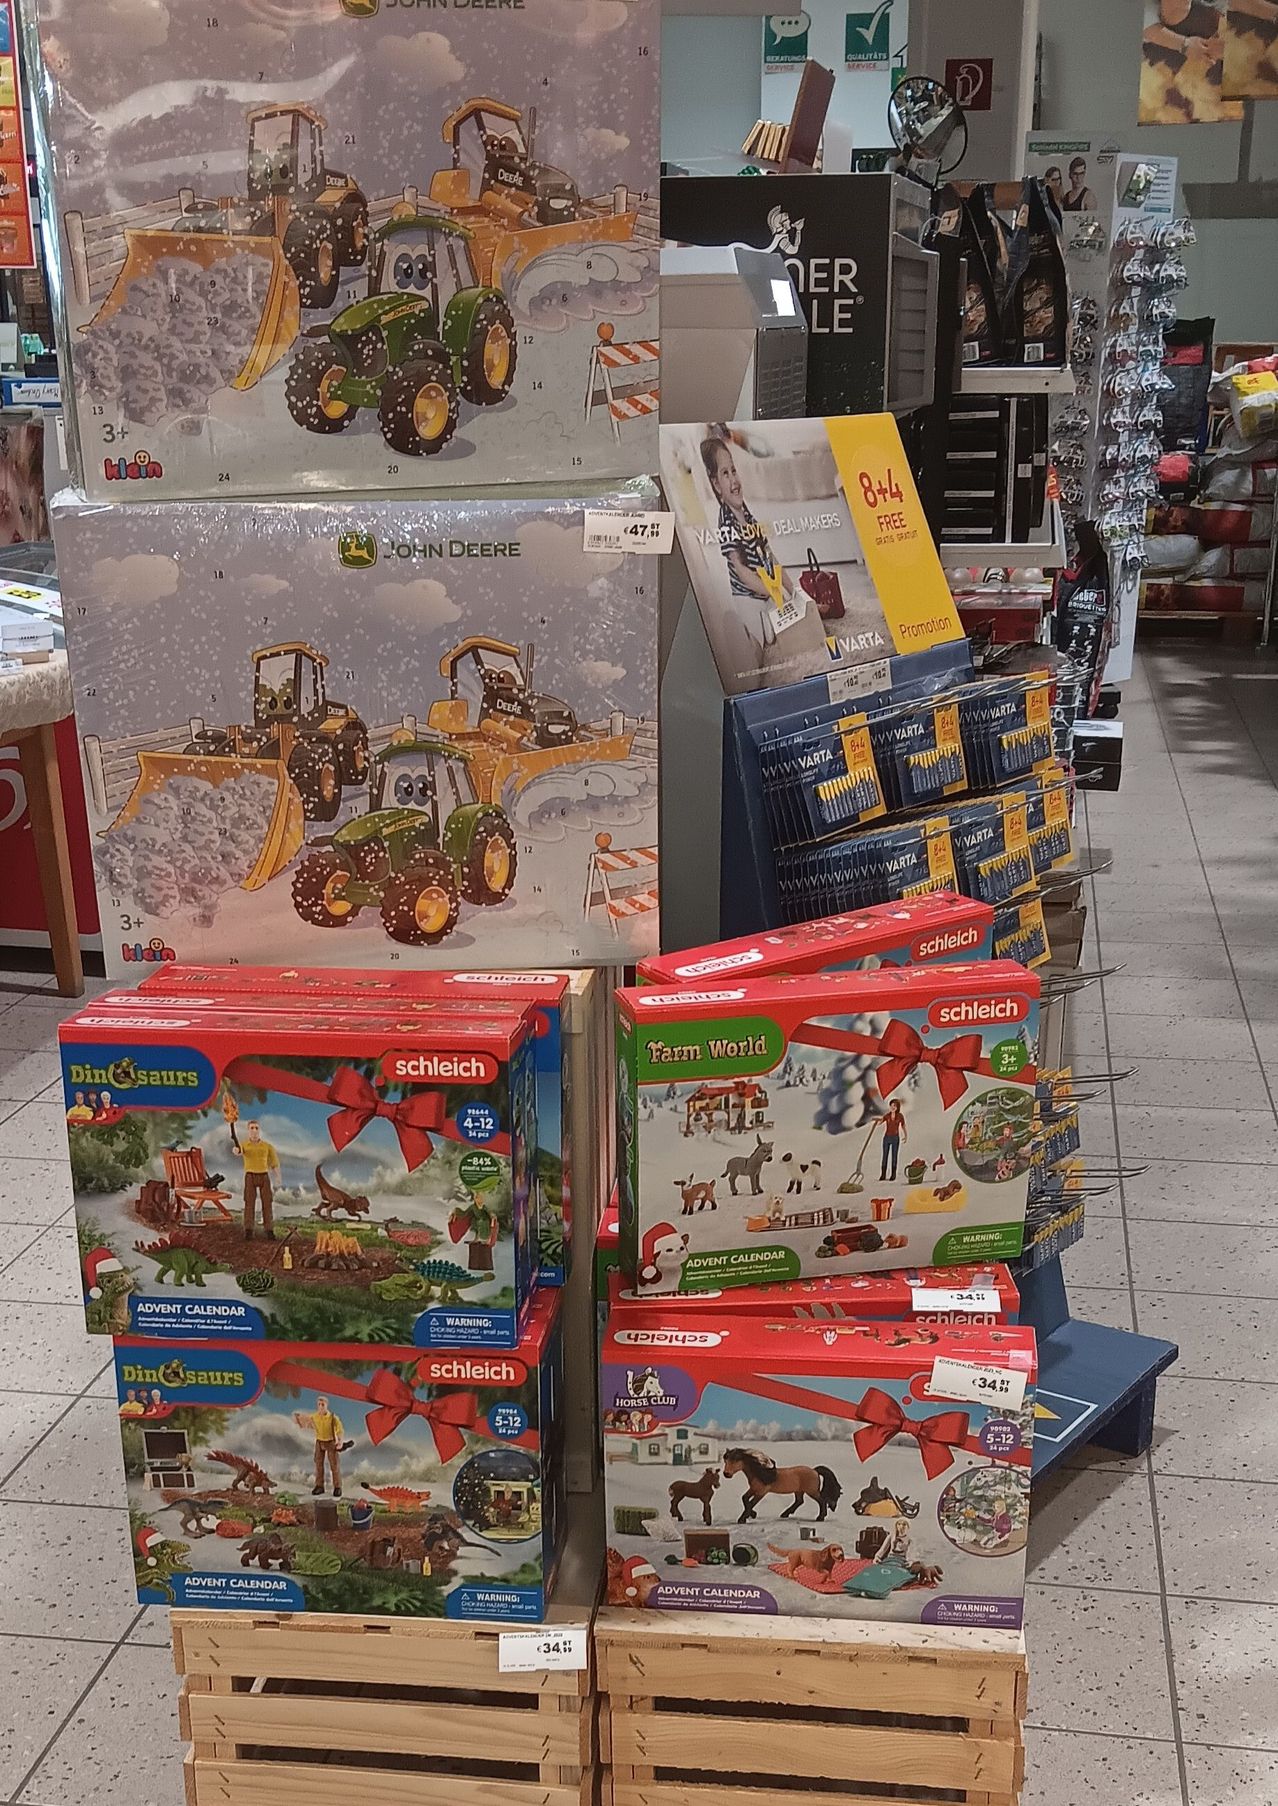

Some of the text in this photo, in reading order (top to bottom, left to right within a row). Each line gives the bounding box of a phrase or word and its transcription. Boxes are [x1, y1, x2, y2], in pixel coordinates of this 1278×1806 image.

[206, 17, 219, 28] 18
[638, 46, 649, 57] 16
[847, 53, 888, 61] QUALITÄTS
[258, 71, 265, 82] 7
[542, 77, 550, 87] 4
[344, 134, 357, 145] 21
[498, 169, 523, 187] DEERE
[638, 192, 649, 202] 19
[586, 261, 592, 270] 8
[210, 279, 216, 289] 9
[169, 293, 181, 303] 10
[346, 289, 357, 299] 11
[562, 293, 568, 303] 6
[207, 316, 219, 326] 23
[523, 336, 534, 345] 12
[532, 381, 543, 391] 14
[92, 406, 104, 416] 13
[102, 423, 129, 444] 3+
[104, 452, 163, 481] klein
[571, 457, 582, 467] 15
[387, 465, 399, 475] 20
[218, 473, 230, 483] 24
[859, 468, 904, 509] 8+4
[876, 512, 907, 532] FREE
[696, 512, 841, 545] VARTA DEAL MAKERS
[875, 529, 918, 547] GRATIS GRATUIT
[384, 540, 521, 558] JOHN DEERE
[214, 570, 224, 580] 18
[635, 586, 645, 596] 16
[77, 607, 87, 616] 17
[263, 617, 268, 626] 7
[899, 615, 952, 640] Promotion
[840, 631, 884, 653] VARTA
[346, 671, 355, 680] 21
[87, 688, 97, 697] 22
[211, 694, 217, 703] 5
[496, 699, 522, 716] DEERE
[990, 702, 1017, 719] VARTA
[894, 724, 925, 740] VARTA
[851, 736, 865, 752] 8+4
[798, 749, 833, 770] VARTA
[584, 778, 590, 787] 8
[181, 807, 192, 816] 10
[350, 807, 358, 815] 11
[218, 827, 228, 836] 23
[964, 828, 994, 847] VARTA
[524, 846, 533, 854] 12
[886, 852, 918, 873] VARTA
[533, 886, 542, 894] 14
[111, 899, 121, 908] 13
[121, 915, 144, 932] 3+
[919, 926, 979, 957] schleich
[122, 941, 176, 963] klein
[390, 952, 400, 961] 20
[571, 949, 581, 958] 15
[229, 958, 239, 967] 24
[685, 954, 752, 975] schleich
[466, 973, 548, 983] schleich
[652, 991, 732, 1003] schleich
[940, 996, 1019, 1023] schleich
[648, 1034, 768, 1065] Farm World
[1001, 1053, 1017, 1065] 3+
[395, 1055, 486, 1078] schleich
[463, 1117, 495, 1131] 4-12
[962, 1232, 1003, 1244] WARNING:
[686, 1250, 786, 1269] ADVENT CALENDAR
[137, 1303, 246, 1317] ADVENT CALENDAR
[446, 1317, 493, 1328] WARNING:
[915, 1311, 996, 1325] schleich
[626, 1332, 709, 1345] schleich
[430, 1360, 515, 1381] schleich
[616, 1396, 676, 1408] HORSE CLUB
[494, 1416, 522, 1428] 5-12
[986, 1434, 1014, 1445] 5-12
[184, 1577, 288, 1591] ADVENT CALENDAR
[476, 1593, 521, 1603] WARNING:
[657, 1586, 761, 1599] ADVENT CALENDAR
[953, 1603, 999, 1613] WARNING:
